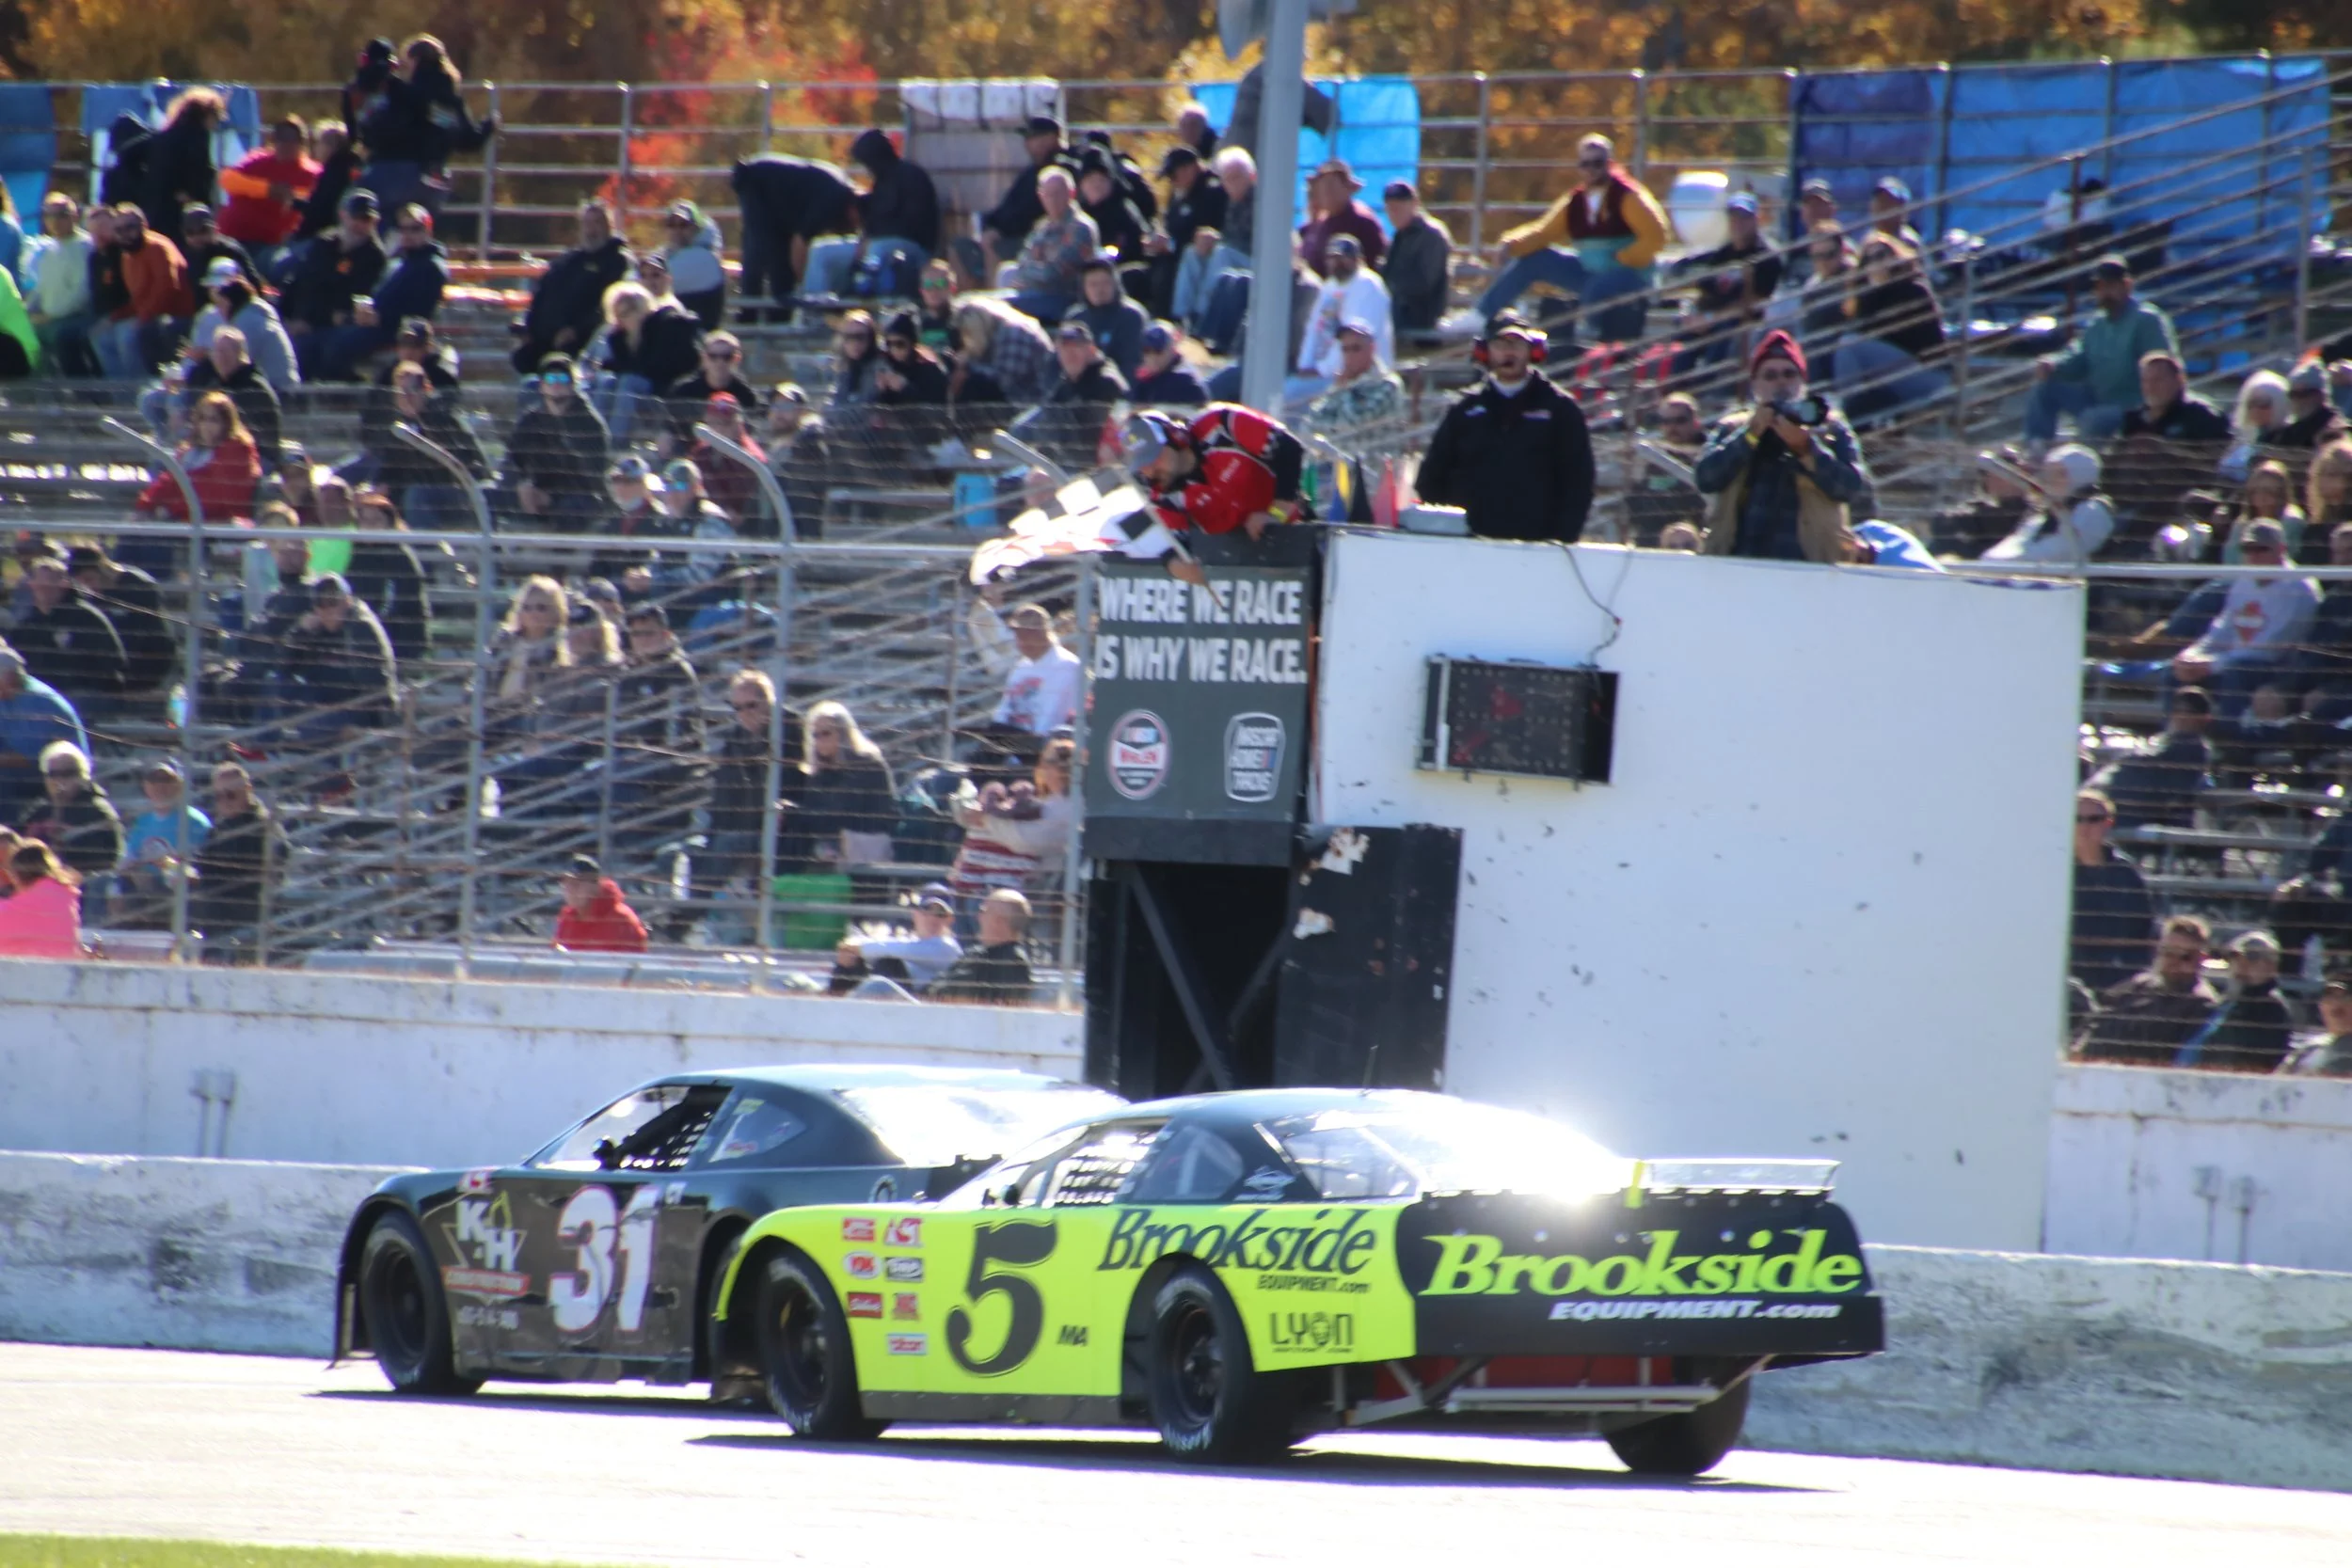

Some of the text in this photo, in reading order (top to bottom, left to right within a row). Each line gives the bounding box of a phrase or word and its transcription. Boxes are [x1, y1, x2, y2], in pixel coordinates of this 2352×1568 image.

[1098, 577, 1303, 625] WHERE WE RACE
[1093, 635, 1309, 684] IS WHY WE RACE.
[548, 1185, 659, 1333] 31
[1097, 1208, 1375, 1275] Brookside
[1418, 1229, 1863, 1296] Brookside
[946, 1219, 1058, 1378] 5
[1549, 1299, 1842, 1323] EQUIPMENT.com
